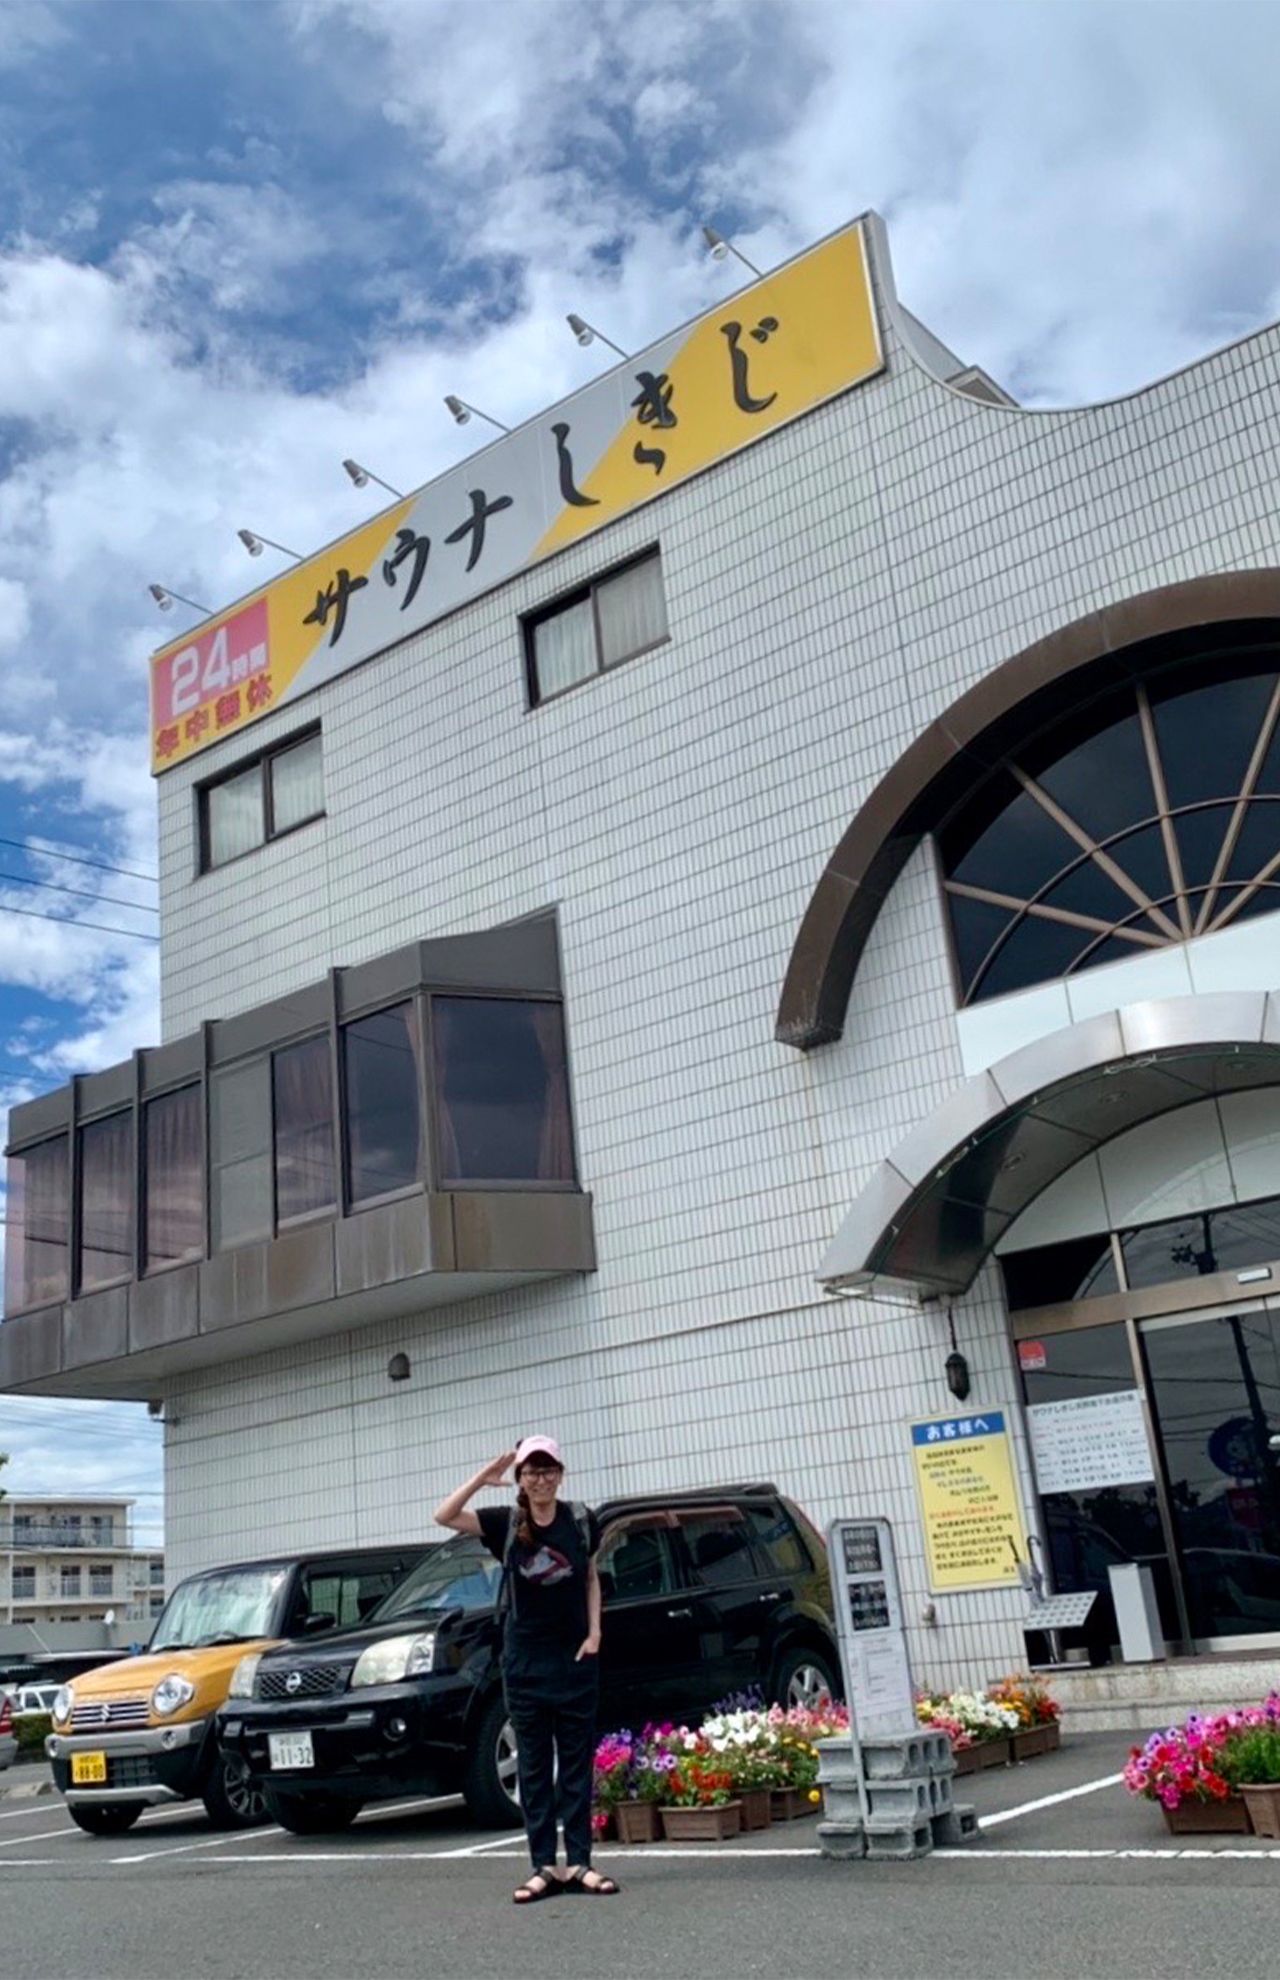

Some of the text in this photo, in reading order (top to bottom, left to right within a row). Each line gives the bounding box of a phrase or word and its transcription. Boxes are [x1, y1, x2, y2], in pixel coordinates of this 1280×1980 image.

[303, 316, 778, 647] サウナしきじ
[926, 1418, 989, 1440] お客様へ
